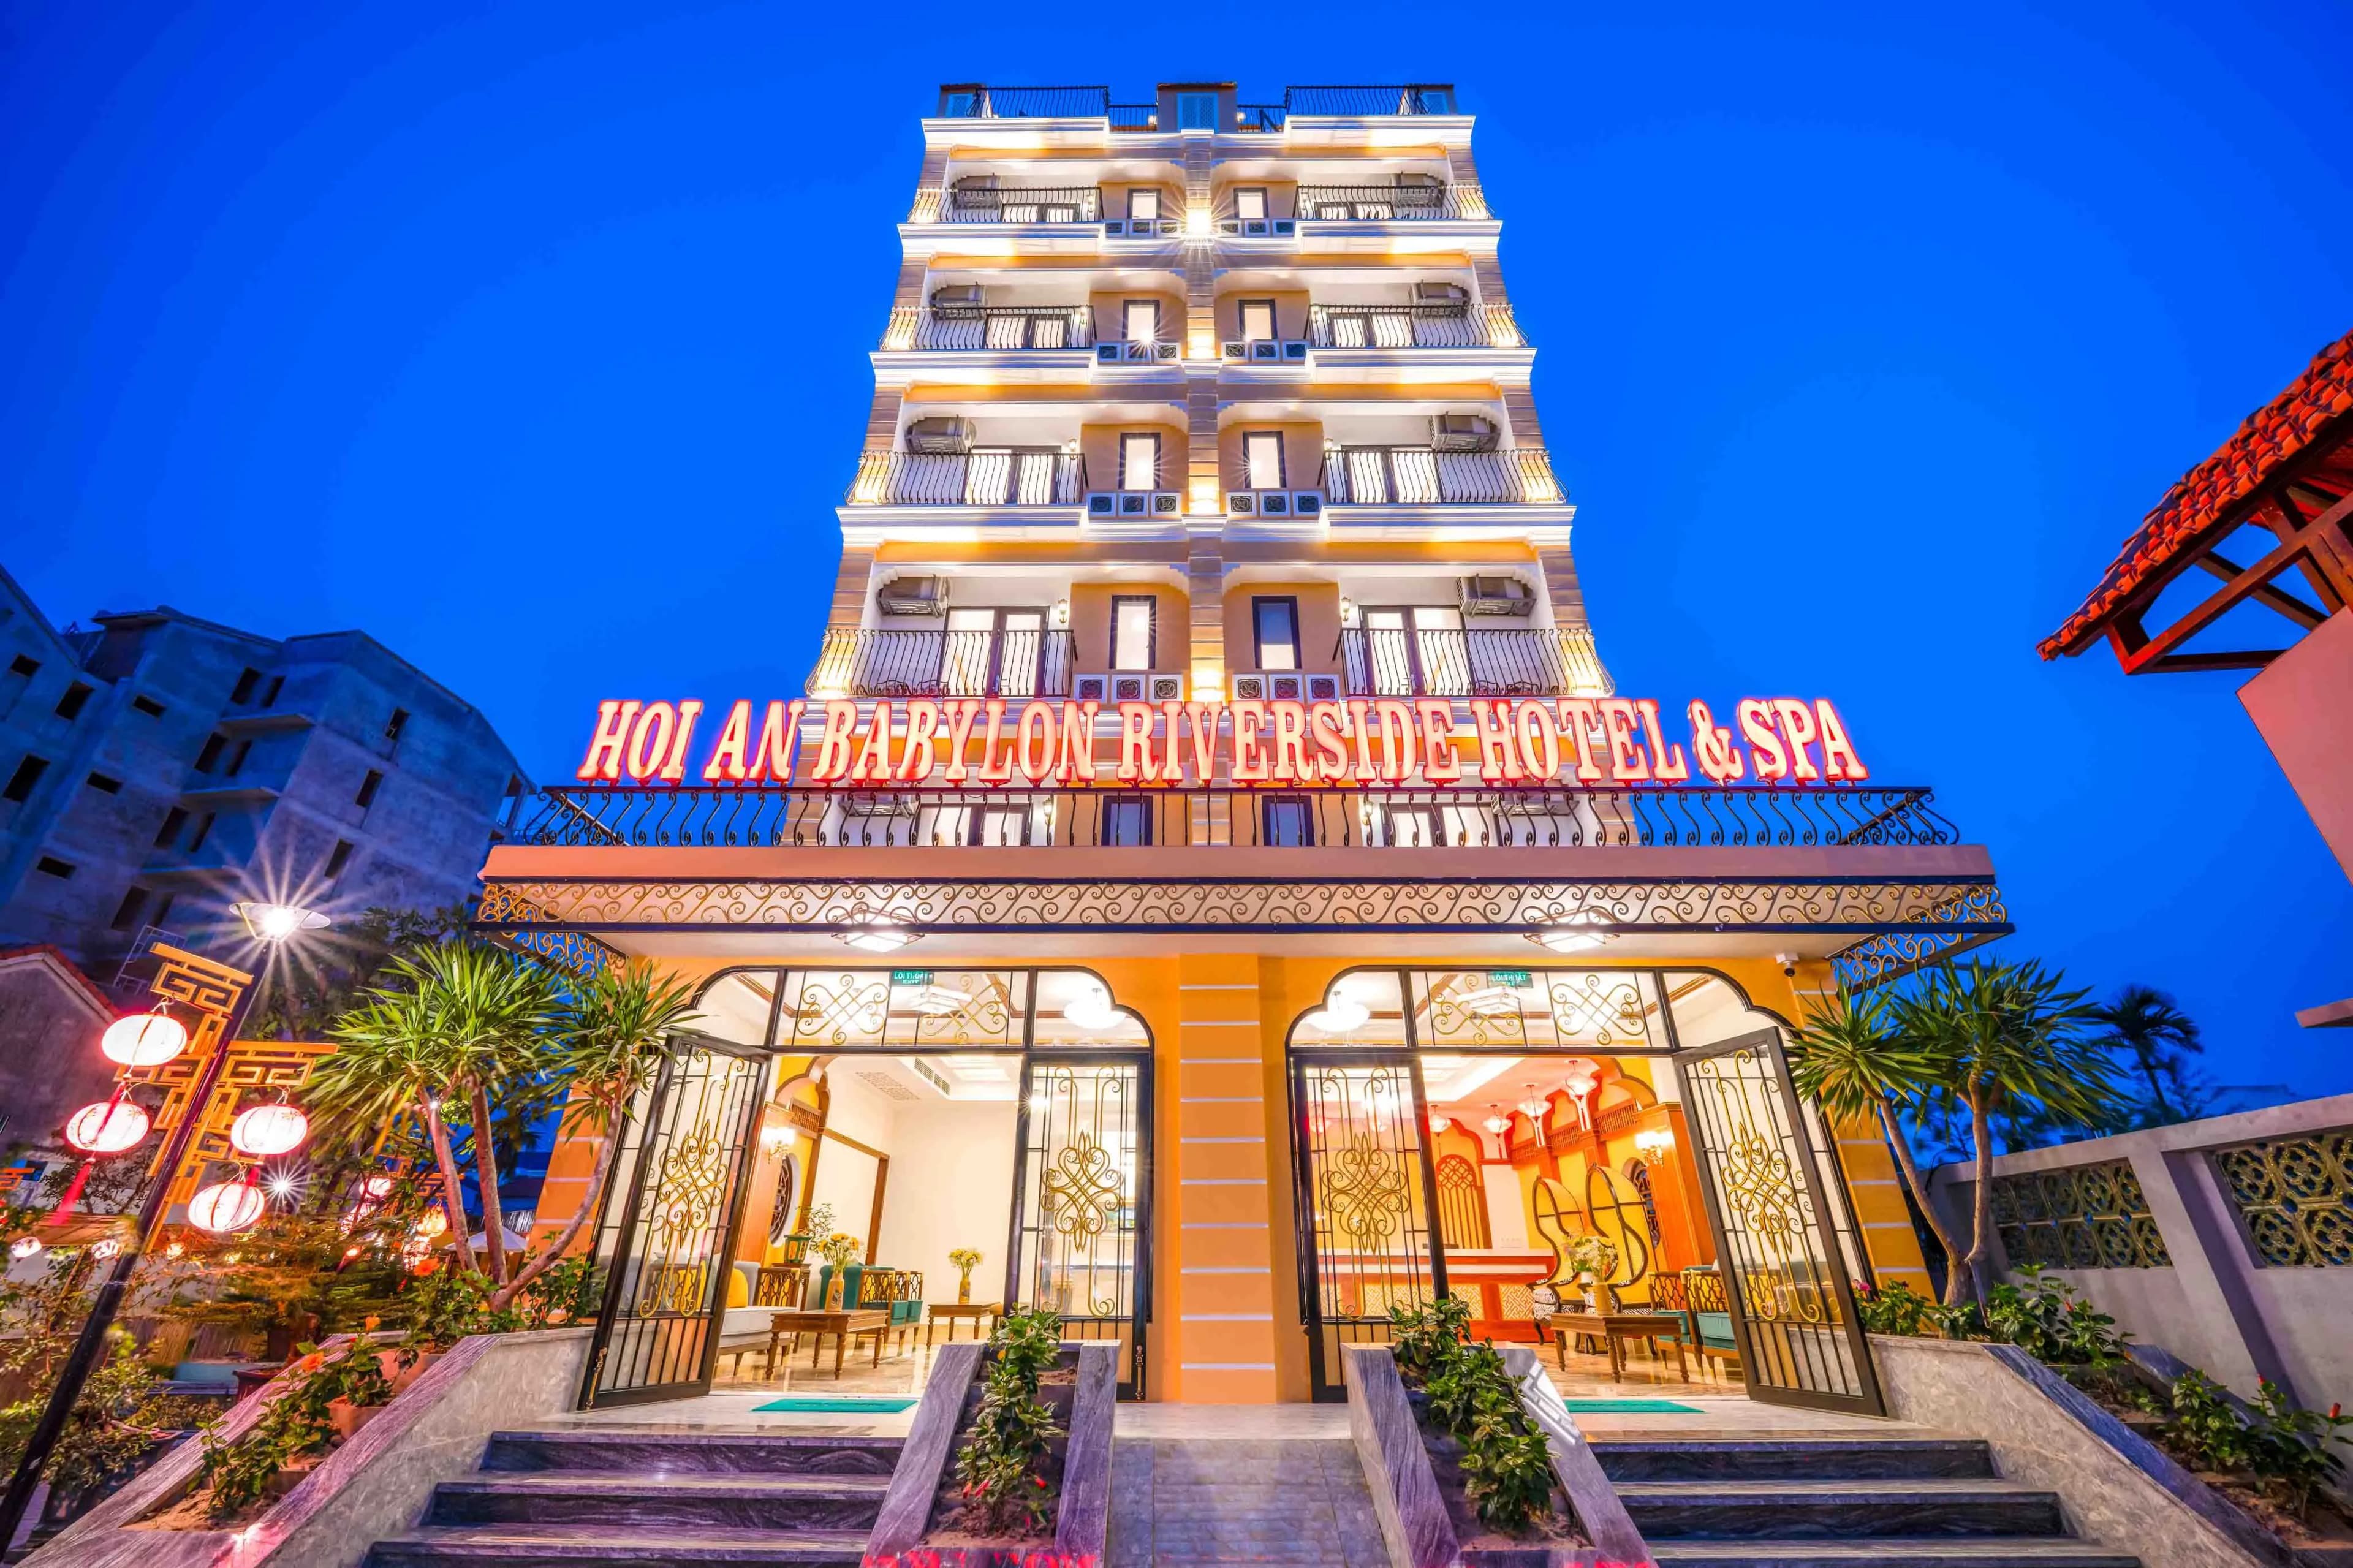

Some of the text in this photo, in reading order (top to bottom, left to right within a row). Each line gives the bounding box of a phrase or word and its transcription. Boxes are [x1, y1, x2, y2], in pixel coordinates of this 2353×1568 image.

[576, 698, 1869, 781] HOI AN BABYLON RIVERSIDE HOTEL & SPA
